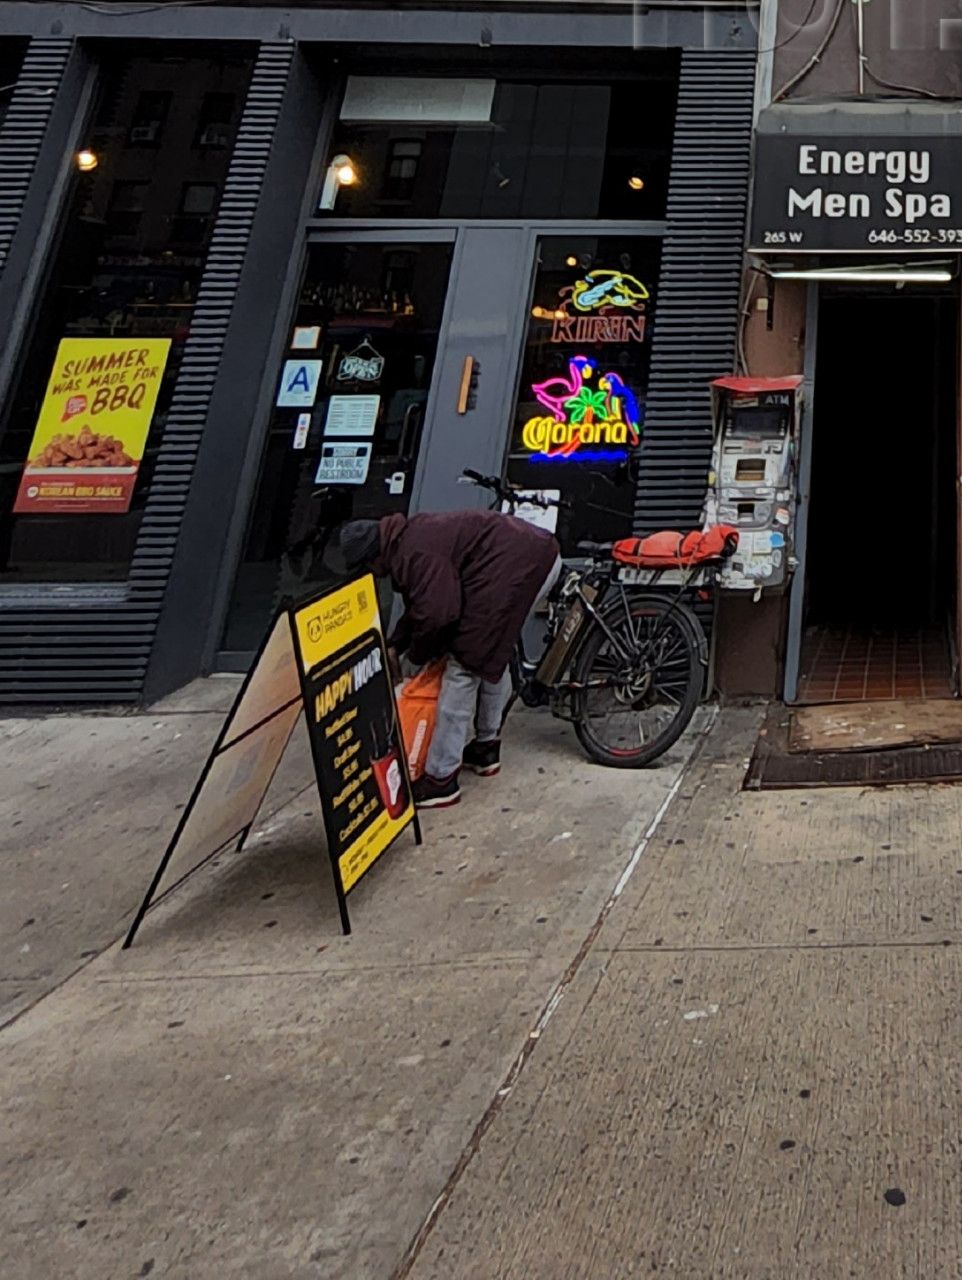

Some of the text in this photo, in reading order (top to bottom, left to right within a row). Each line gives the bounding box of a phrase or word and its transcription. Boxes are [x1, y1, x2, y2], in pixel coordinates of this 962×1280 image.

[799, 144, 931, 184] Energy
[788, 188, 951, 223] Men Spa
[764, 231, 786, 244] 265
[789, 231, 803, 244] W
[61, 348, 150, 379] SUMMER
[287, 366, 310, 392] A
[52, 366, 160, 396] WAS MADE FOR
[90, 382, 147, 416] BBQ
[765, 394, 790, 406] ATM
[522, 416, 628, 456] Corona
[315, 669, 352, 723] HAPPY
